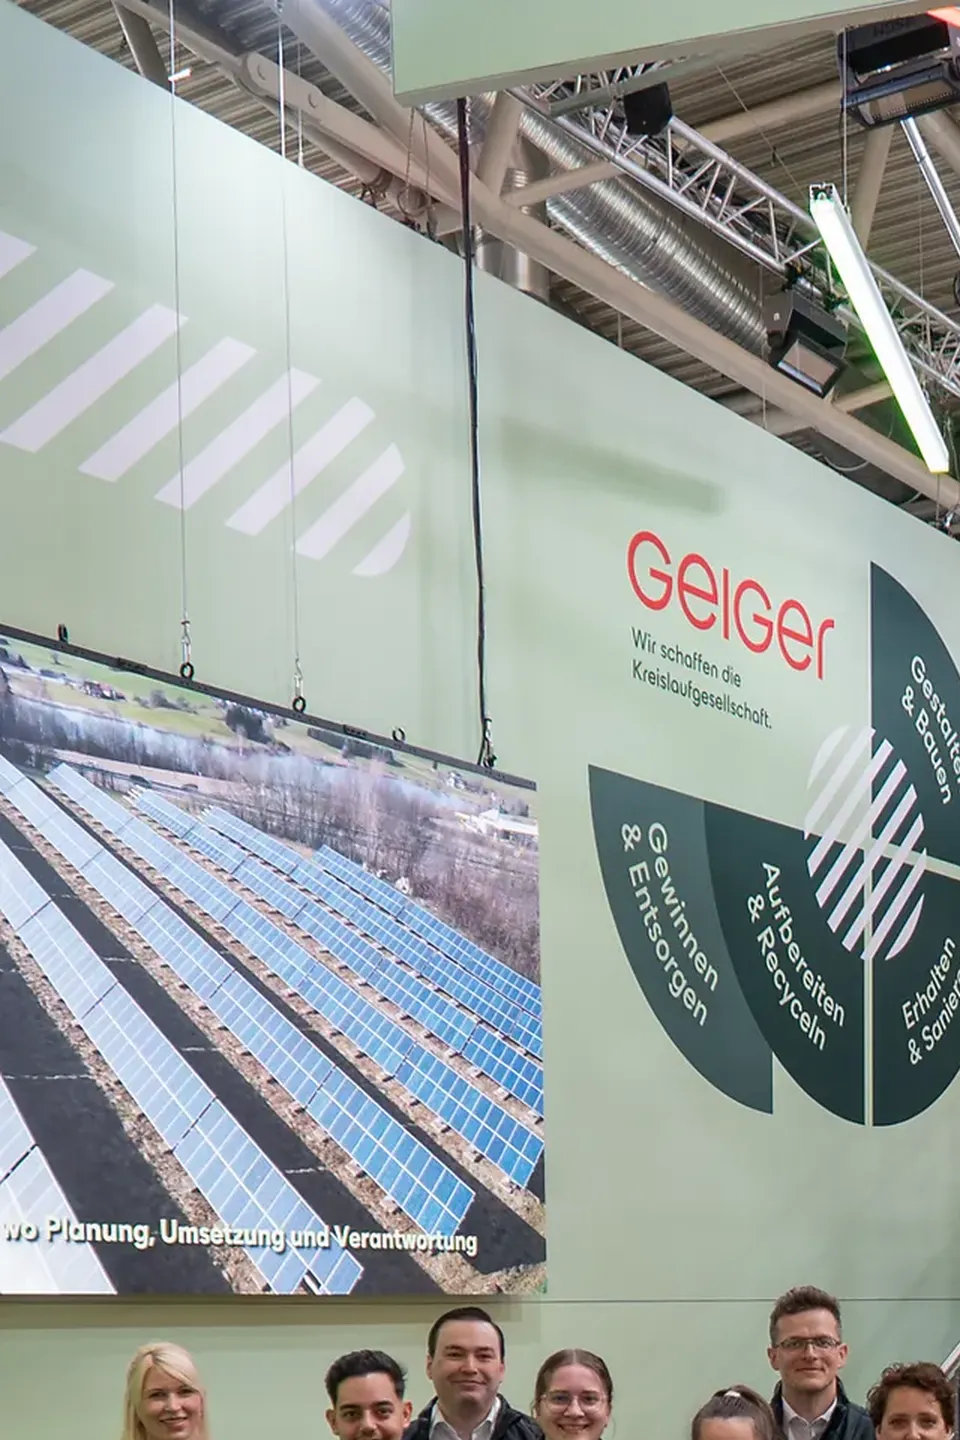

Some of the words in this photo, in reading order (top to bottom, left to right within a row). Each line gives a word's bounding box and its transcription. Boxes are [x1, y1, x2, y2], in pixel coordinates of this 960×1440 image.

[631, 626, 656, 654] Wir
[660, 643, 719, 679] schaffen
[721, 665, 742, 688] die
[632, 658, 773, 729] Kreislaufgesellschaft.
[902, 685, 914, 717] &
[915, 708, 952, 805] Bauen
[621, 823, 642, 852] &
[628, 861, 708, 1026] Entsorgen
[648, 822, 719, 991] Gewinnen
[762, 862, 845, 1027] Aufbereiten
[747, 893, 765, 923] &
[757, 925, 826, 1051] Recyceln
[902, 937, 956, 1029] Erhalten
[907, 1038, 922, 1065] &
[4, 1222, 39, 1242] wo
[45, 1215, 156, 1248] Planung,
[160, 1218, 285, 1255] Umsetzung
[290, 1225, 330, 1248] und
[331, 1224, 478, 1256] Verantwortung
